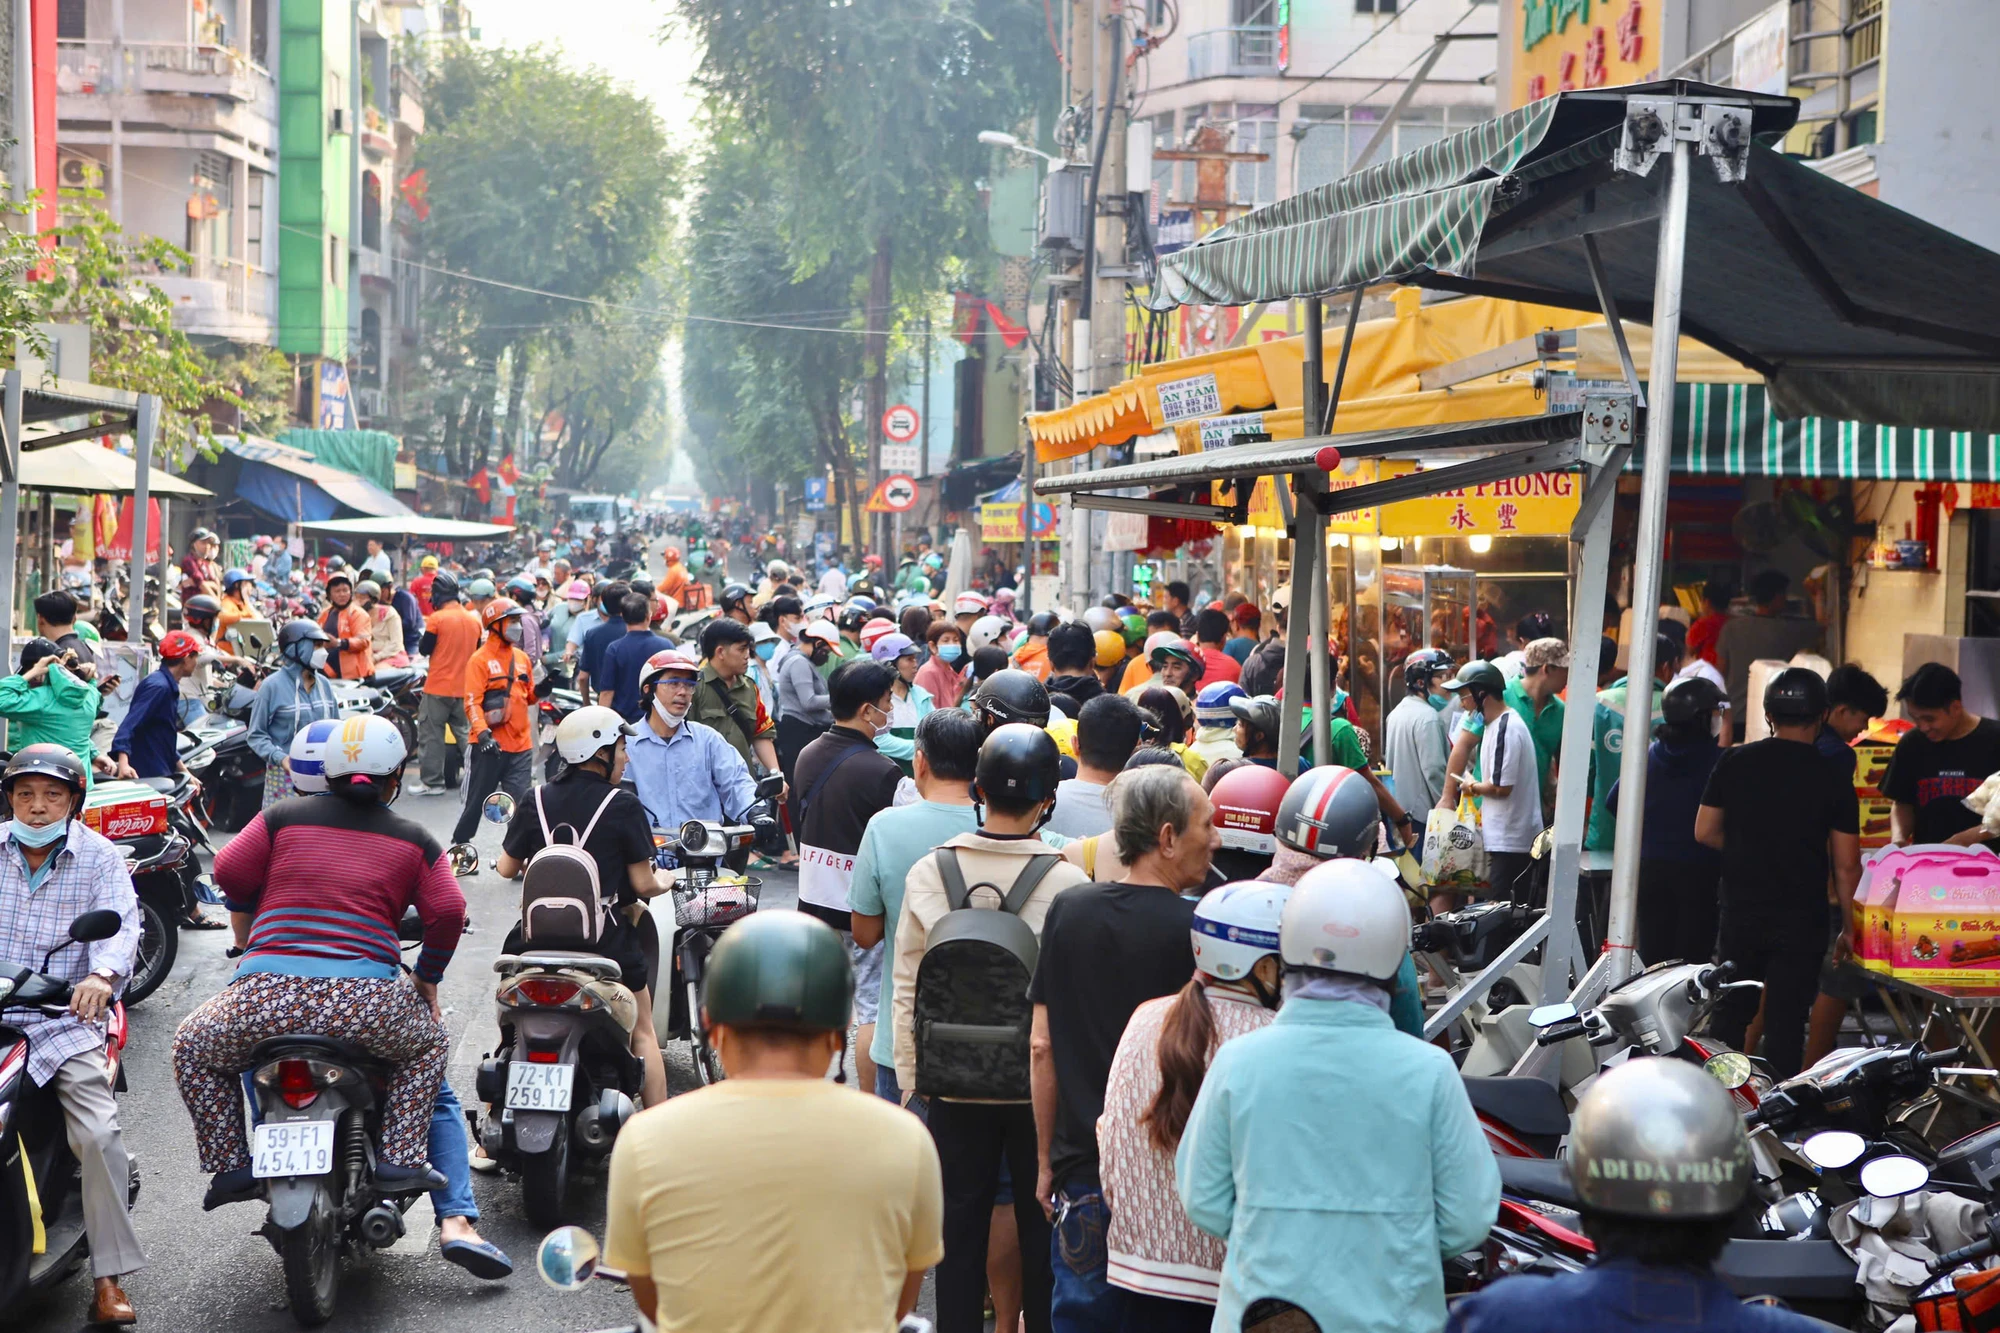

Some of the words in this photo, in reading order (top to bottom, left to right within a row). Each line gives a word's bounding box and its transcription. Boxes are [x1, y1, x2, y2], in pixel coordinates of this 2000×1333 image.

[1162, 392, 1180, 403] AN
[1185, 385, 1215, 398] TÂM
[1163, 401, 1183, 411] 0902
[1186, 398, 1200, 407] 695
[1203, 394, 1217, 403] 761
[1203, 402, 1218, 410] 987
[1204, 429, 1223, 439] AN
[1204, 438, 1226, 449] 0902
[518, 1066, 563, 1087] 72-K1
[509, 1087, 568, 1108] 259.12
[268, 1126, 319, 1149] 59-F1
[258, 1149, 327, 1173] 454.19
